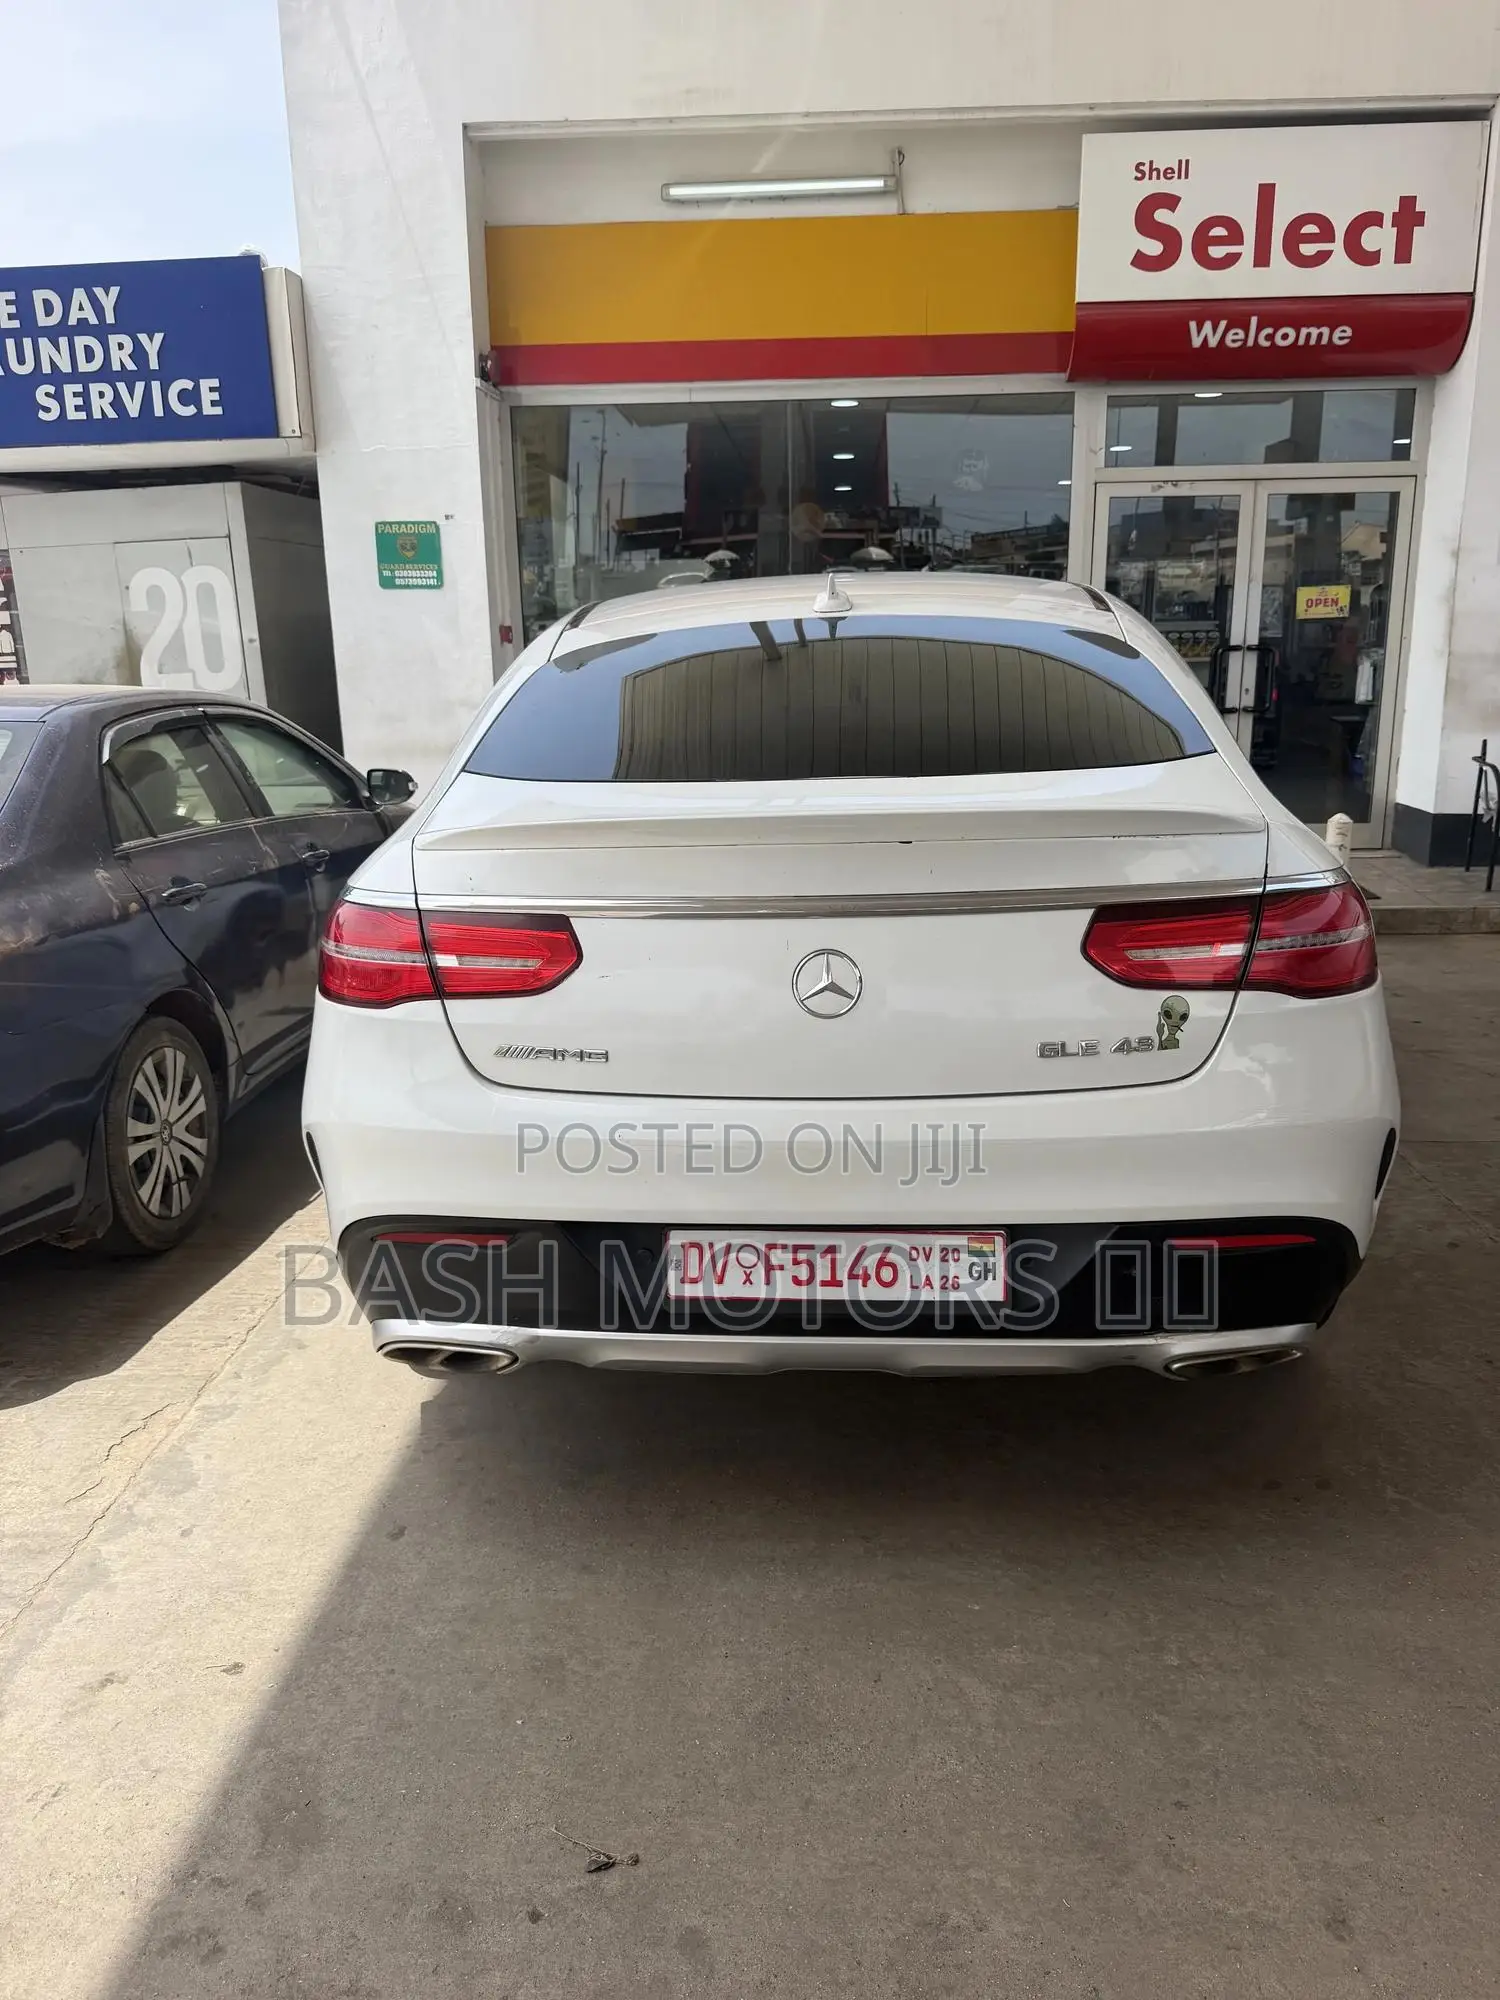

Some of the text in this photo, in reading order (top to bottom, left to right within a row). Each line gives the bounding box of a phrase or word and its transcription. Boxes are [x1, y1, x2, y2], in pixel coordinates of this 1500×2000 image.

[1134, 158, 1191, 181] Shell
[1130, 182, 1426, 272] Select
[32, 285, 121, 327] DAY
[1188, 315, 1353, 349] Welcome
[0, 332, 165, 376] UNDRY
[35, 378, 224, 422] SERVICE
[377, 523, 436, 534] PARADIGM
[1305, 597, 1339, 609] OPEN
[128, 564, 243, 691] 20
[1036, 1039, 1101, 1058] GLE
[909, 1246, 961, 1262] DV 20
[910, 1275, 934, 1290] LA
[968, 1261, 997, 1281] GH
